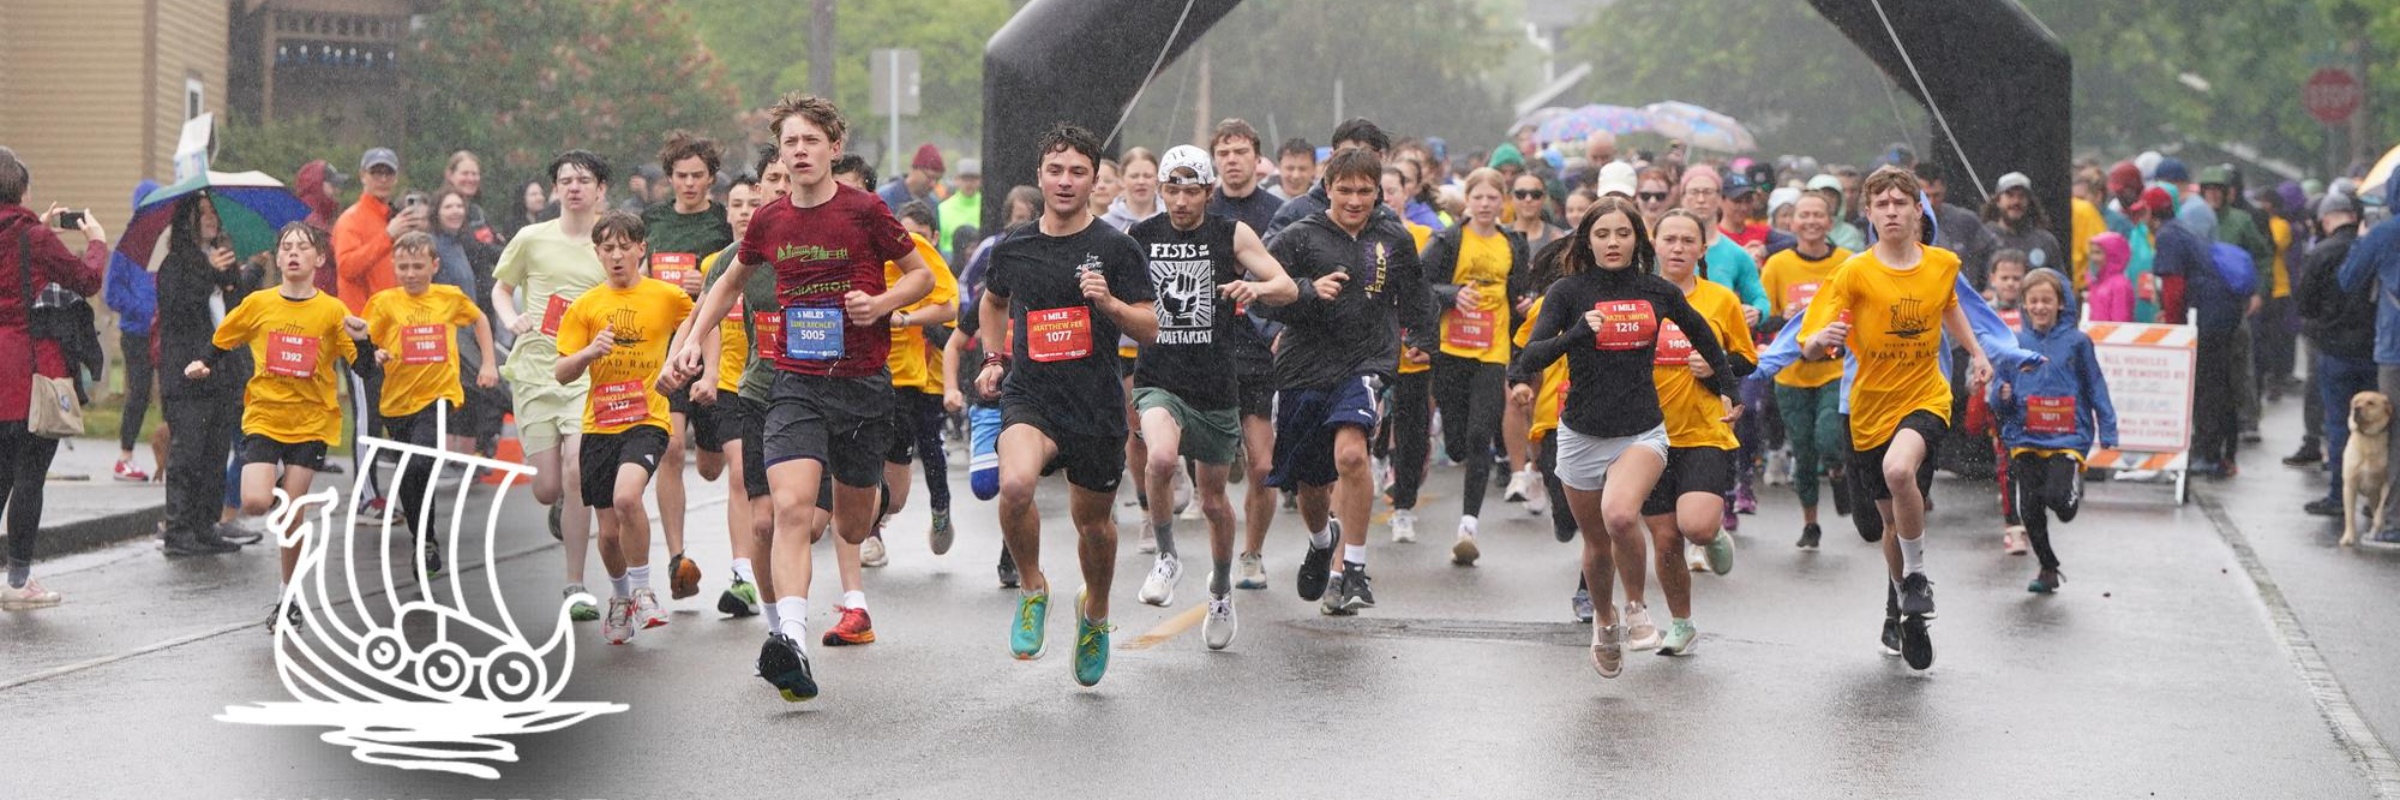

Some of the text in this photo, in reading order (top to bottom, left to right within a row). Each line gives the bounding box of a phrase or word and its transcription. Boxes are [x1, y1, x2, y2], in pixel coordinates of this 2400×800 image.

[1150, 243, 1197, 258] FISTS
[661, 270, 682, 281] 1240
[1618, 303, 1637, 311] MILE
[802, 310, 824, 319] MILES
[1042, 311, 1069, 321] 1 MILE
[1033, 320, 1084, 332] MATTHEW FEE
[1615, 322, 1640, 333] 1216
[801, 329, 826, 341] 5005
[1046, 330, 1073, 342] 1077
[1156, 329, 1214, 345] ROLETARIAT
